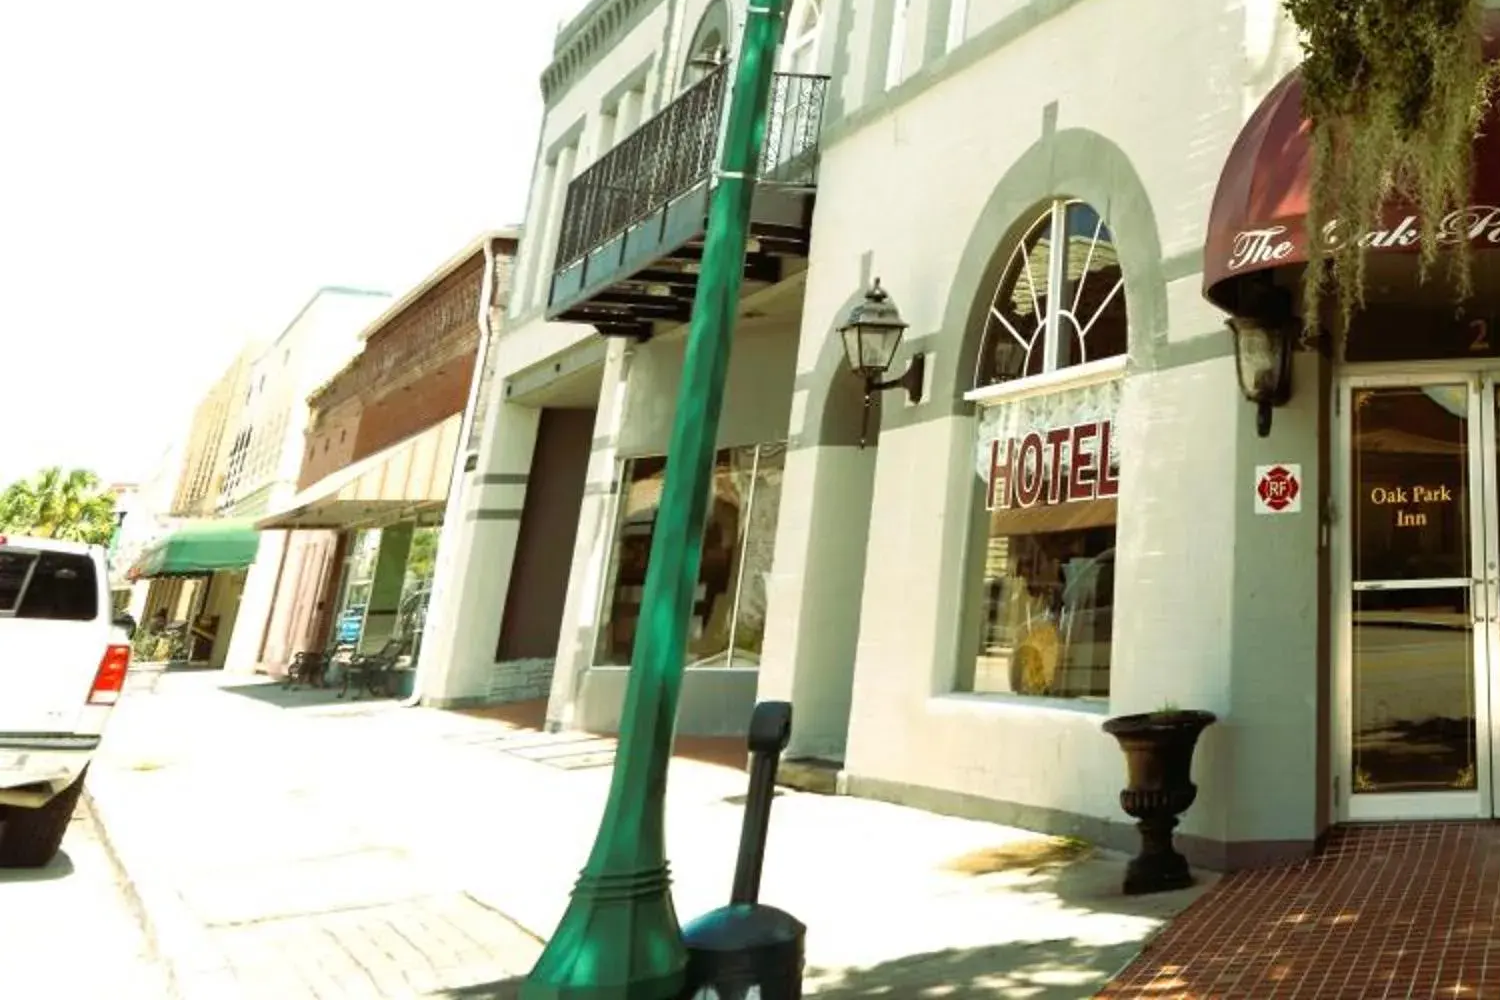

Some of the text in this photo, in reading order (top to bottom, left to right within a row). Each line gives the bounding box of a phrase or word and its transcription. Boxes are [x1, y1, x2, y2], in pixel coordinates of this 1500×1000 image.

[1227, 225, 1294, 270] The
[1469, 319, 1489, 350] 2
[985, 420, 1119, 511] HOTEL
[1269, 480, 1287, 497] RF
[1371, 485, 1452, 505] Oak Park
[1396, 510, 1427, 527] Inn
